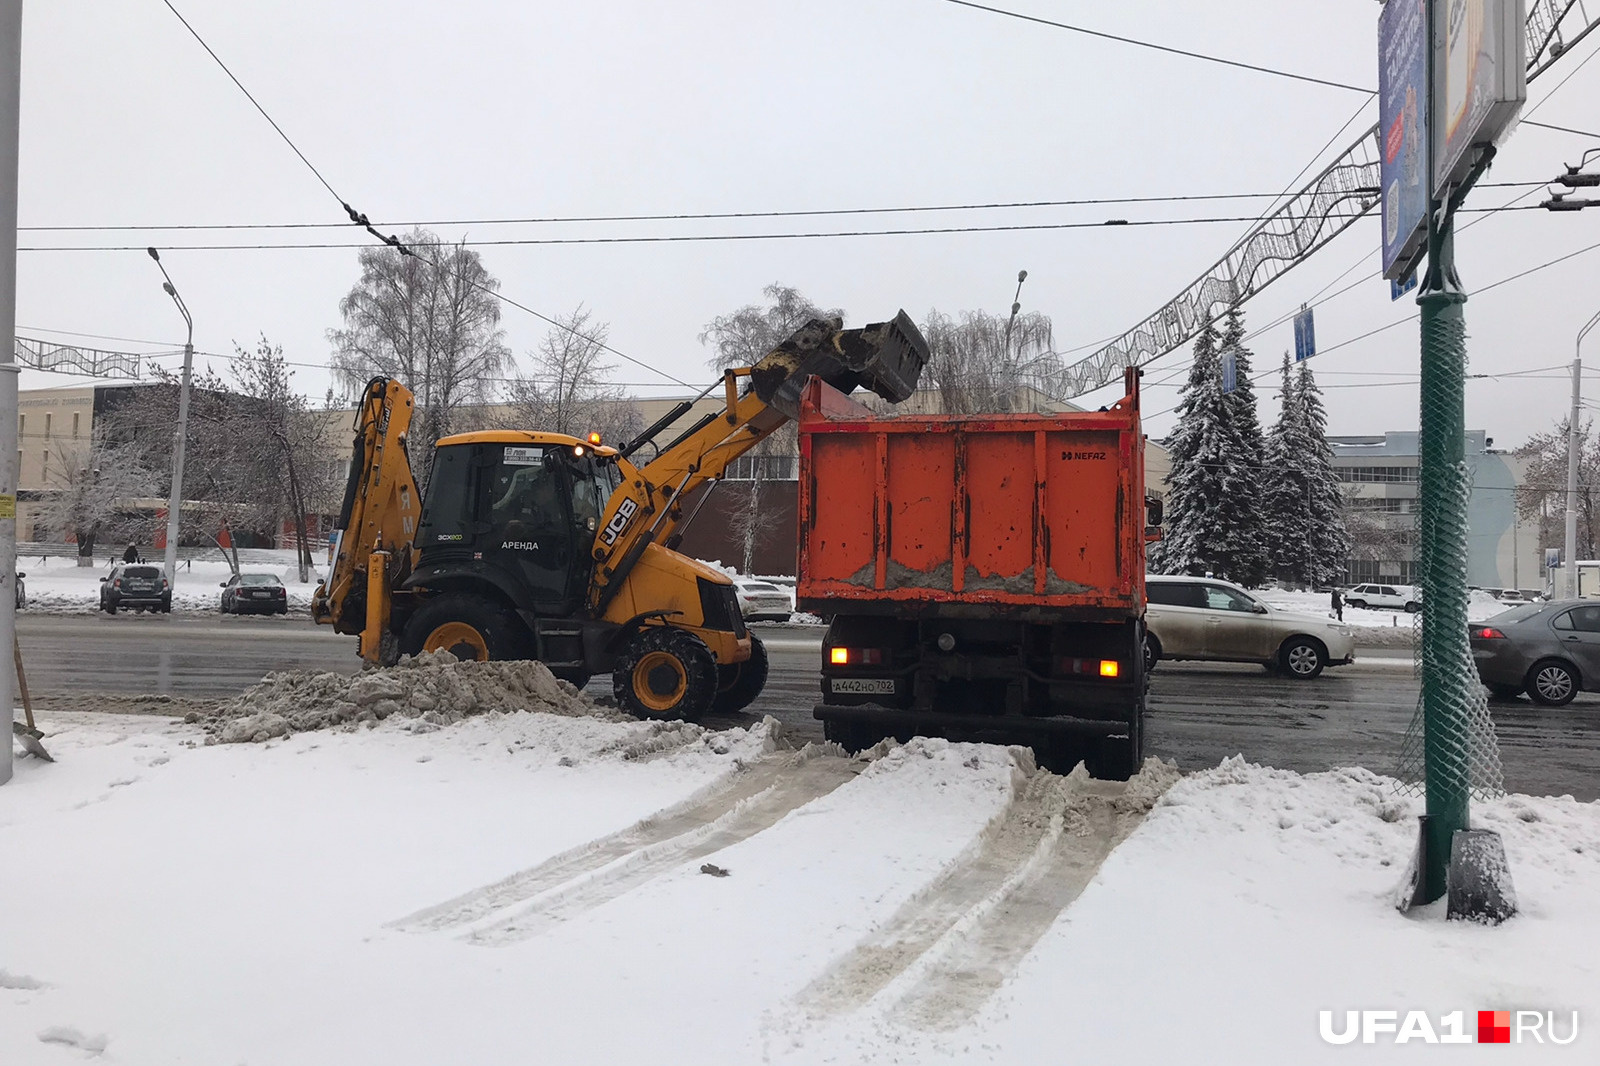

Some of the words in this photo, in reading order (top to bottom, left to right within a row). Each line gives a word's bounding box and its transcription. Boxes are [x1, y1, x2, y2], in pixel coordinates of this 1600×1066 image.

[1074, 452, 1106, 460] NEFAZ
[605, 498, 637, 545] JCB
[501, 541, 539, 551] АРЕНДА
